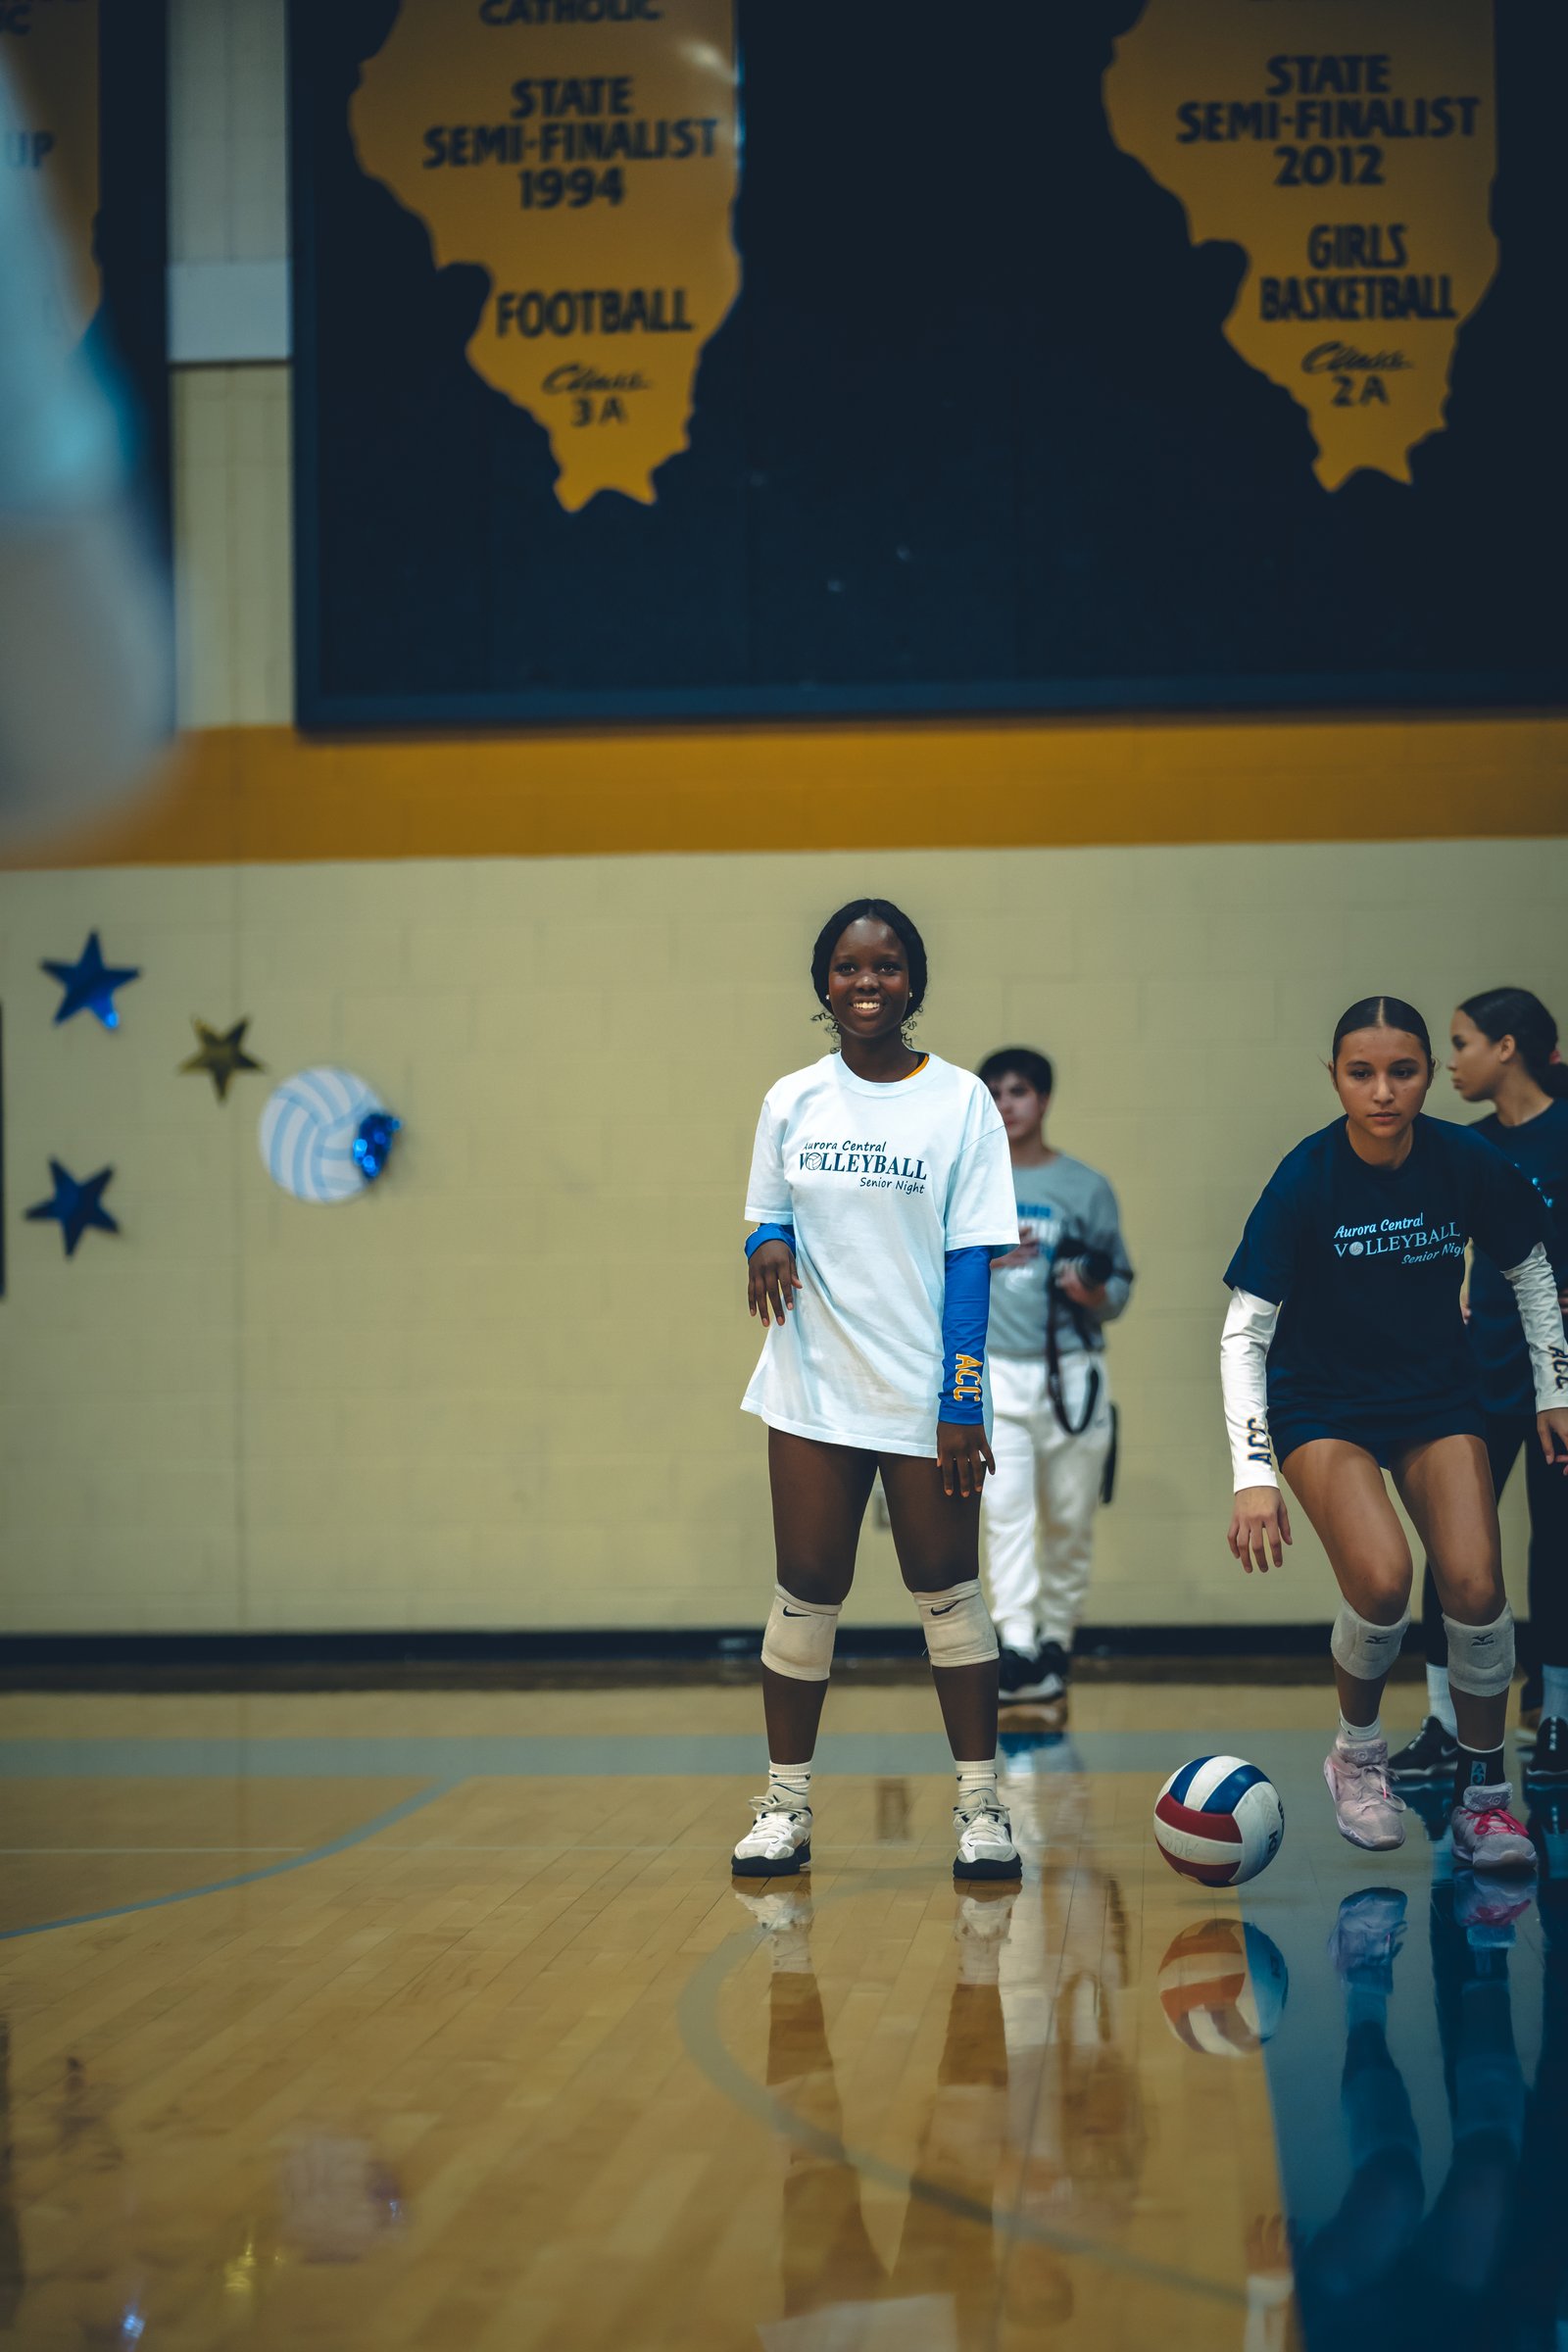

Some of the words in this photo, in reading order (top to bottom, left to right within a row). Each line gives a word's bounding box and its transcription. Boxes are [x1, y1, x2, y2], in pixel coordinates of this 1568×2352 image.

[1265, 54, 1391, 96] STATE
[510, 75, 634, 119] STATE
[1176, 97, 1480, 143] SEMI-FINALIST
[422, 118, 717, 169] SEMI-FINALIST
[1273, 145, 1384, 186] 2012
[518, 168, 626, 209] 1994
[1307, 223, 1408, 270] GIRLS
[496, 287, 695, 338] FOOTBALL
[1259, 274, 1457, 321] BASKETBALL
[799, 1152, 927, 1181] VOLLEYBALL
[804, 1141, 838, 1151] Aurora
[842, 1140, 887, 1152] Central
[859, 1177, 893, 1189] Senior
[895, 1180, 925, 1196] Night
[1333, 1224, 1377, 1239] Aurora
[1380, 1211, 1424, 1232] Central
[1333, 1221, 1461, 1258] VOLLEYBALL
[1401, 1250, 1440, 1264] Senior
[953, 1353, 984, 1401] ACC
[1247, 1416, 1273, 1466] ACC
